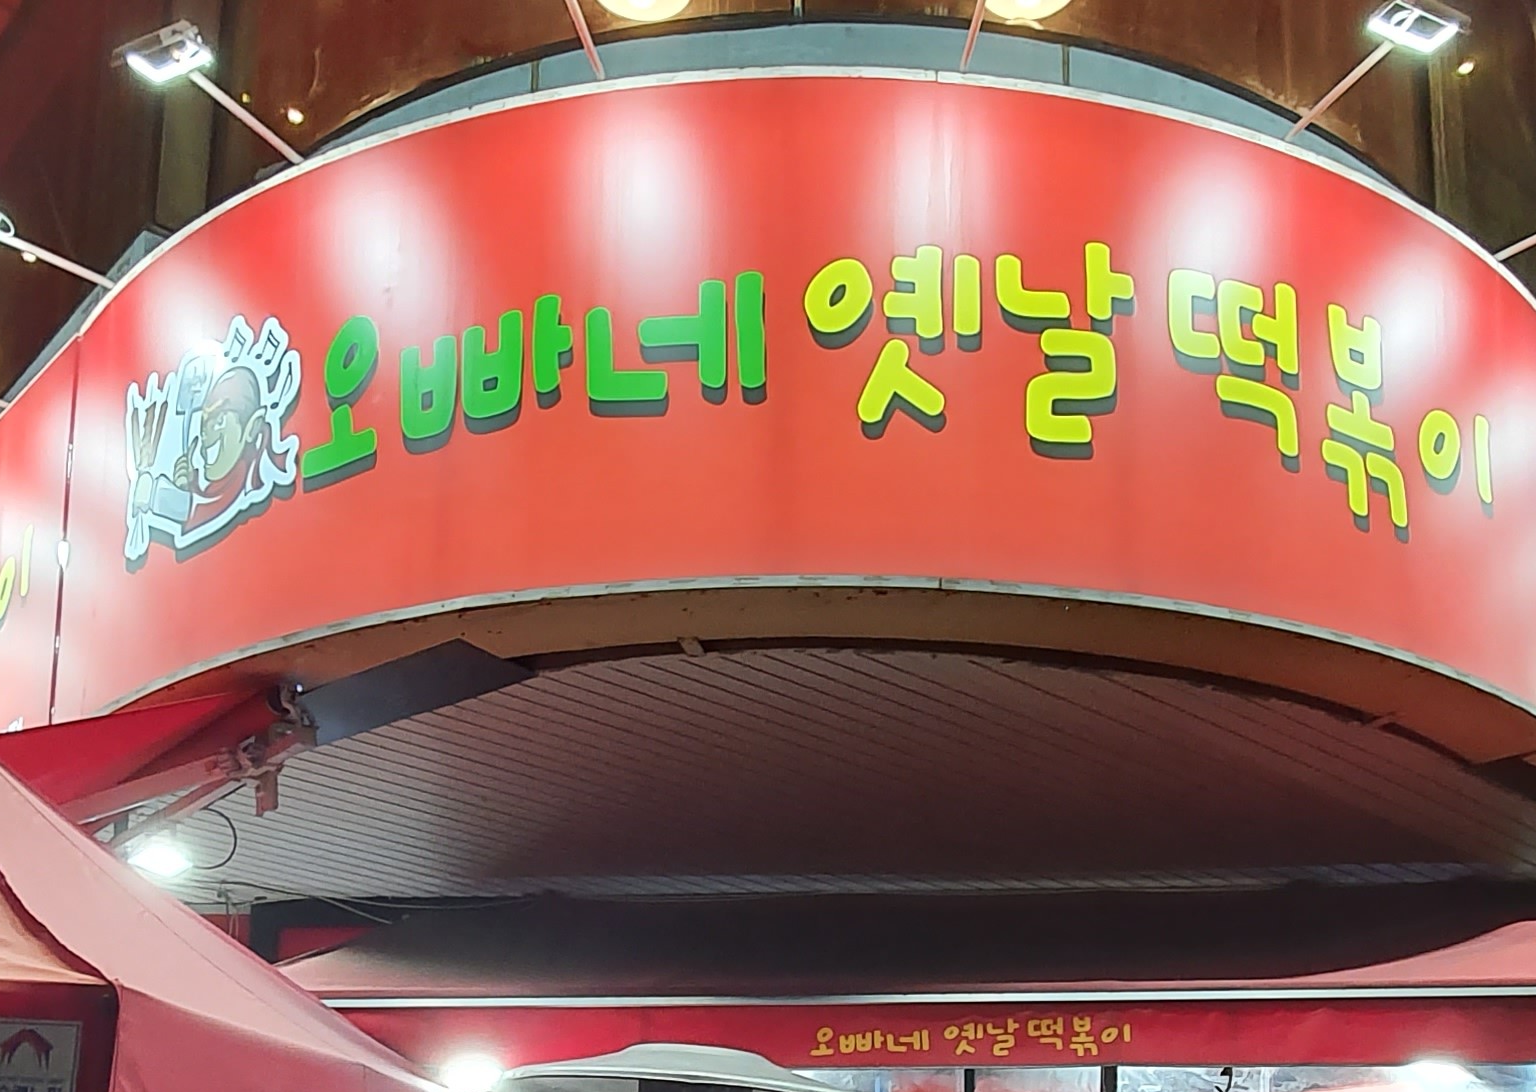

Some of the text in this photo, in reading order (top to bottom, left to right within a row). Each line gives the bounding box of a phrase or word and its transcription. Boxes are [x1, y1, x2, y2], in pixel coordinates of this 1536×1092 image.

[302, 241, 1494, 530] 오빠네 옛날 떡볶이
[809, 1016, 1132, 1057] 오빠네 옛날 떡볶이
